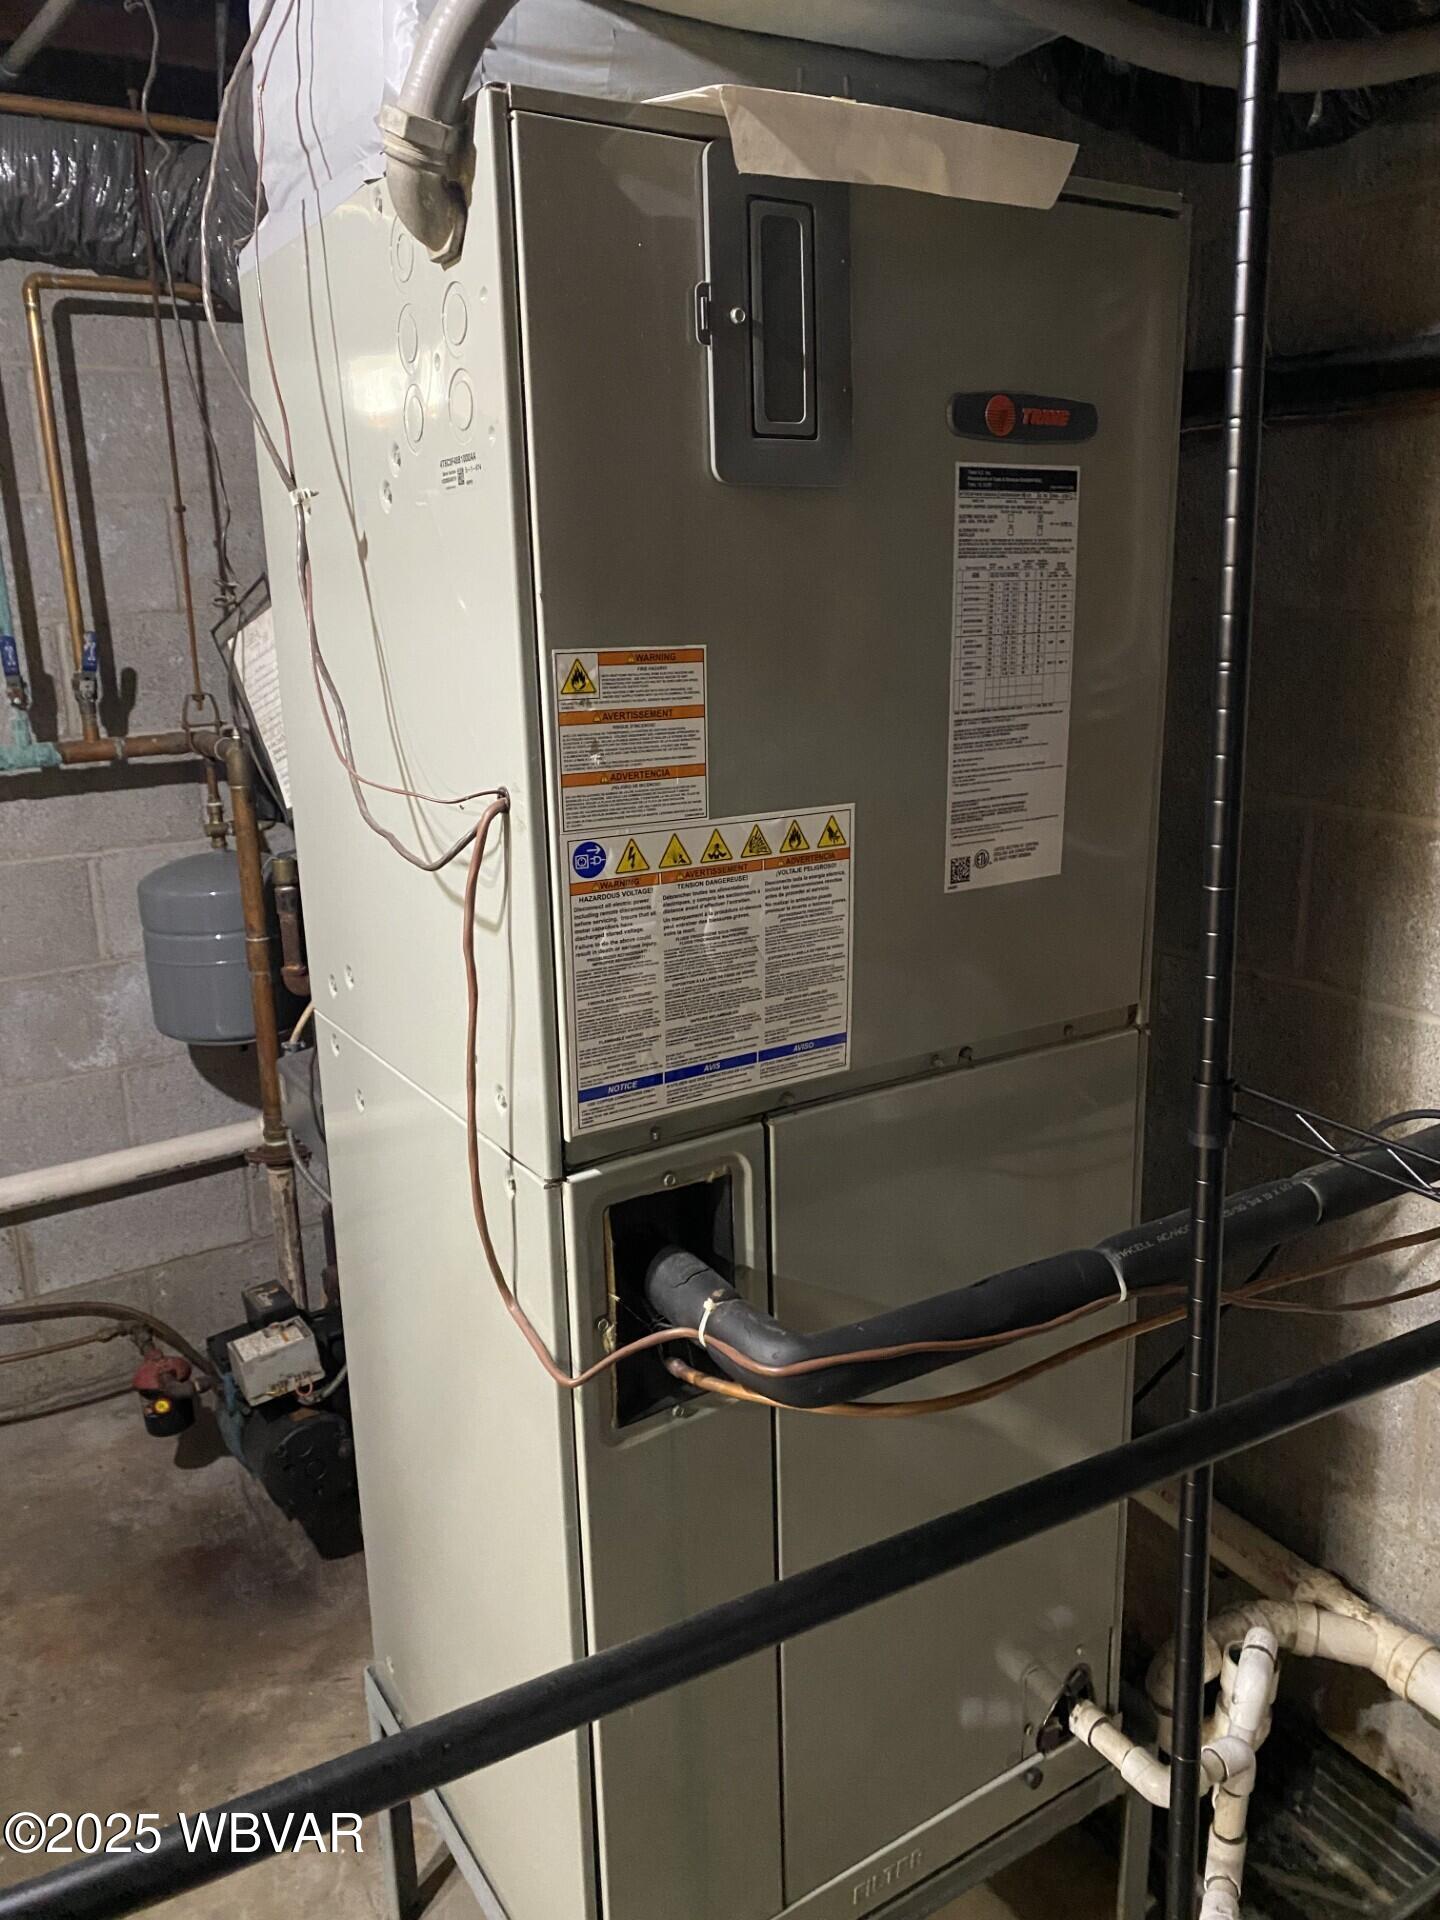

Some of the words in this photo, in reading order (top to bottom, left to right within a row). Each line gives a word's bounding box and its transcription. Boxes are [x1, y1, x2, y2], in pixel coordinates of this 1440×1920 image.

[1022, 408, 1071, 428] TRANE
[636, 653, 676, 662] WARNING
[603, 709, 673, 721] AVERTISSEMENT
[610, 768, 670, 782] ADVERTENCIA
[786, 852, 836, 864] ADVERTENCIA
[685, 864, 748, 878] AVERTISSEMENT
[600, 878, 640, 889] WARNING
[678, 881, 704, 889] TENSION
[705, 875, 749, 886] DANGEREUSE!
[579, 892, 620, 903] HAZARDOUS
[622, 888, 653, 897] VOLTAGE!
[793, 1042, 814, 1052] AVISO
[704, 1062, 720, 1072] AVIS
[608, 1081, 638, 1094] NOTICE
[852, 1848, 922, 1905] FILTER
